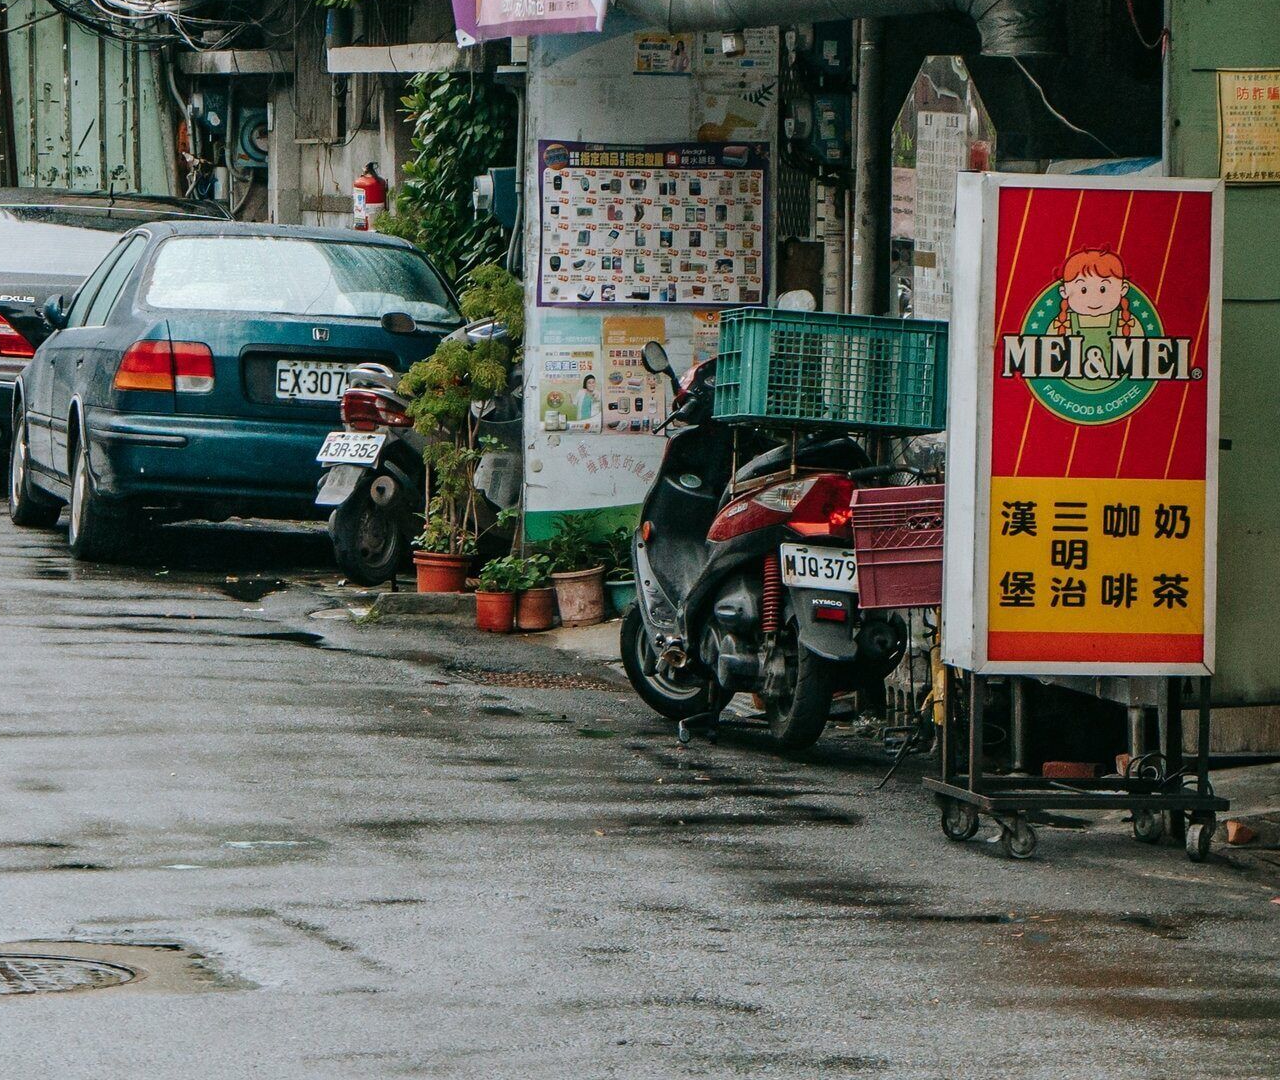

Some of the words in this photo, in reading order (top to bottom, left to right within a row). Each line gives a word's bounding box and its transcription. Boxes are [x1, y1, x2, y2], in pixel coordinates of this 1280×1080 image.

[1043, 384, 1095, 416] FAST-FOOD
[1105, 385, 1142, 413] COFFEE
[812, 599, 843, 607] KYMCO
[1000, 500, 1037, 608] 漢堡
[1051, 501, 1089, 608] 三明治
[1102, 504, 1141, 609] 咖啡
[1153, 504, 1192, 609] 奶茶
